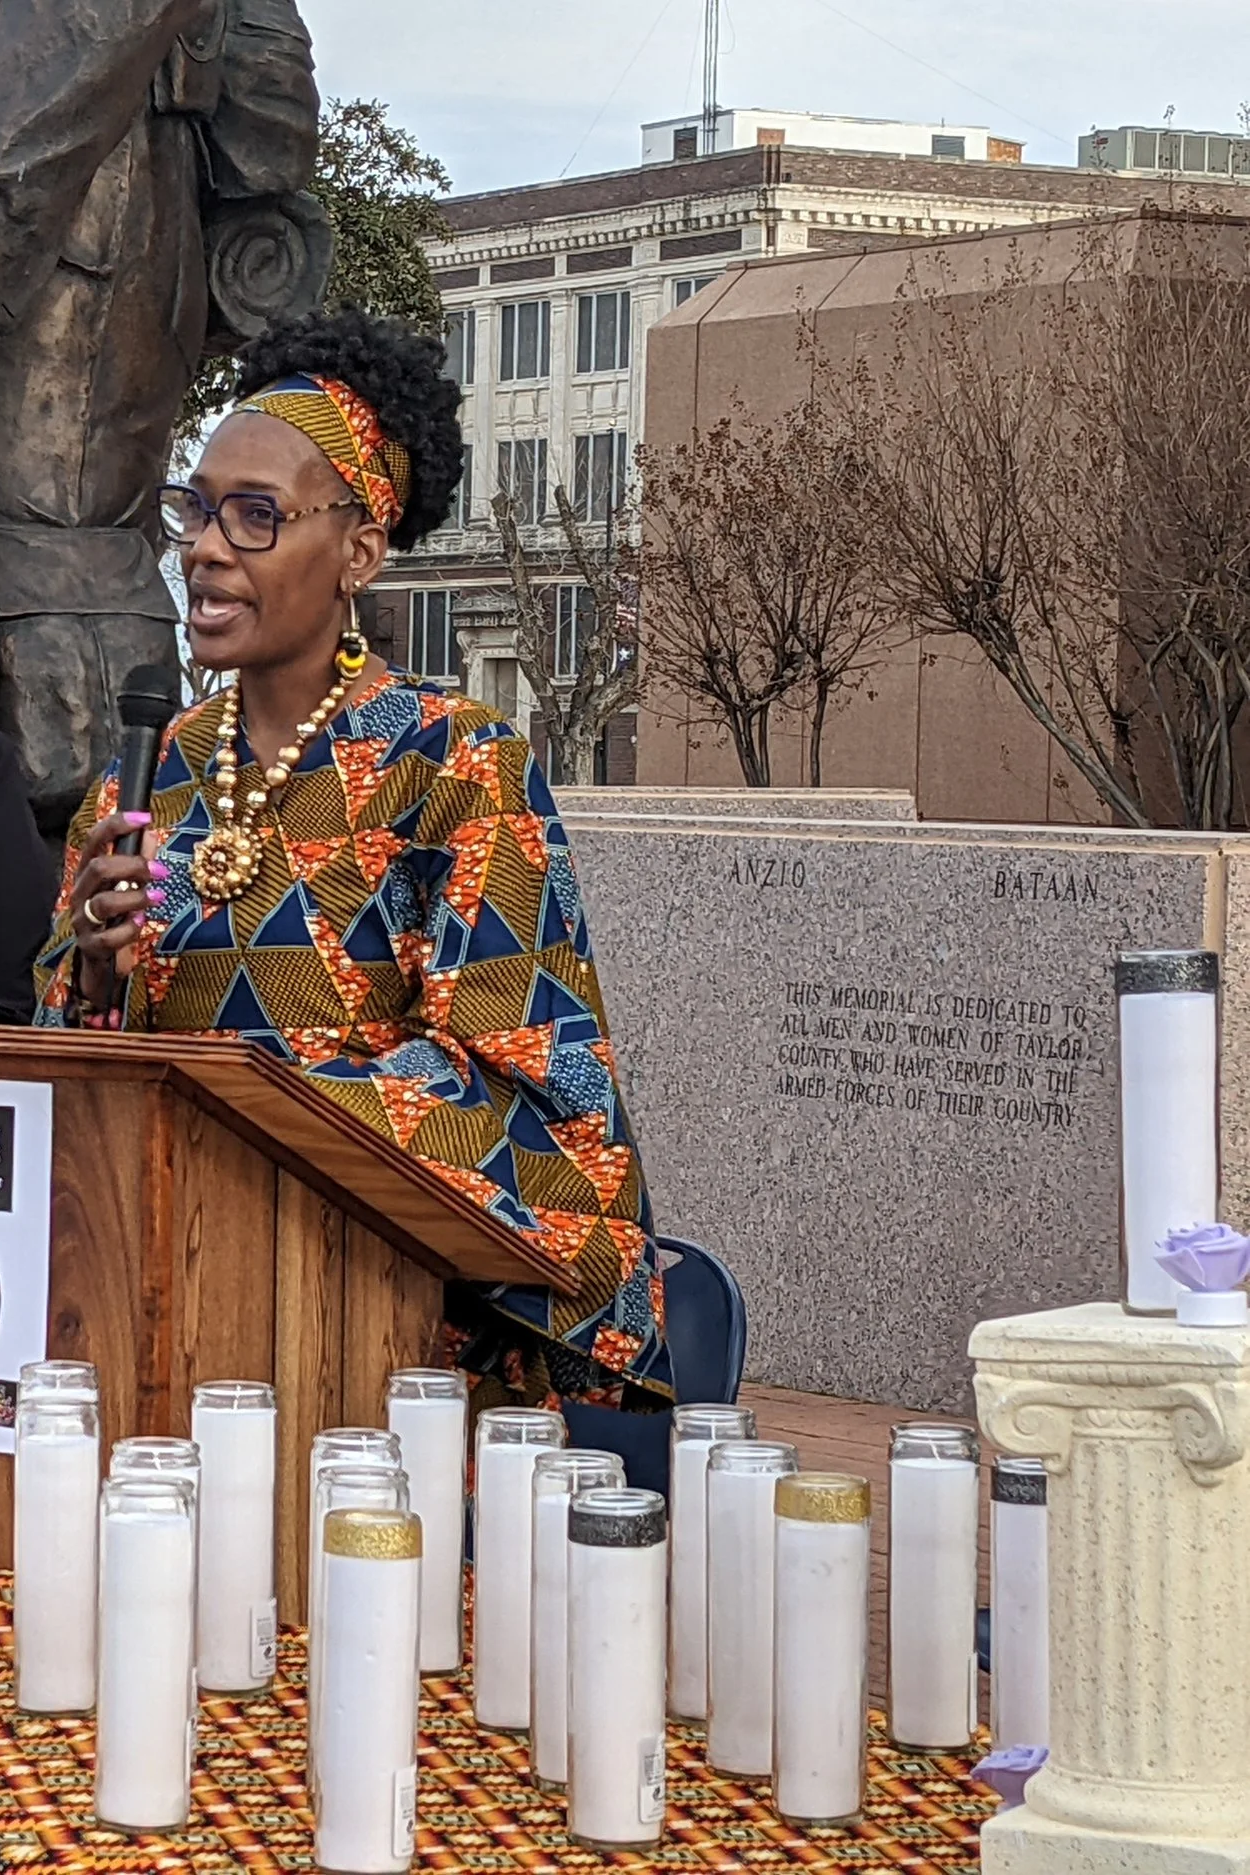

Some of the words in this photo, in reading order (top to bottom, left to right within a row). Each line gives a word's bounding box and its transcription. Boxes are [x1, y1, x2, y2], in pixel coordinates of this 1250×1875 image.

[729, 859, 805, 888] ANZIO
[994, 870, 1099, 901] BATAAN
[785, 982, 820, 1006] THIS
[831, 987, 915, 1013] MEMORIAL
[925, 994, 941, 1015] IS
[952, 996, 1050, 1025] DEDICATED
[1062, 1005, 1086, 1028] TO
[780, 1014, 809, 1035] ALL
[817, 1017, 851, 1040] MEN
[863, 1020, 897, 1044] AND
[907, 1024, 969, 1050] WOMEN
[980, 1030, 1003, 1053] OF
[1016, 1034, 1082, 1060] TAYLOR
[778, 1044, 841, 1069] COUNTY
[850, 1050, 884, 1074] WHO
[893, 1053, 936, 1079] HAVE
[945, 1060, 1005, 1086] SERVED
[1017, 1067, 1034, 1088] IN
[1047, 1069, 1078, 1096] THE
[906, 1088, 926, 1110] OF
[937, 1091, 983, 1117] THEIR
[994, 1098, 1076, 1132] COUNTRY
